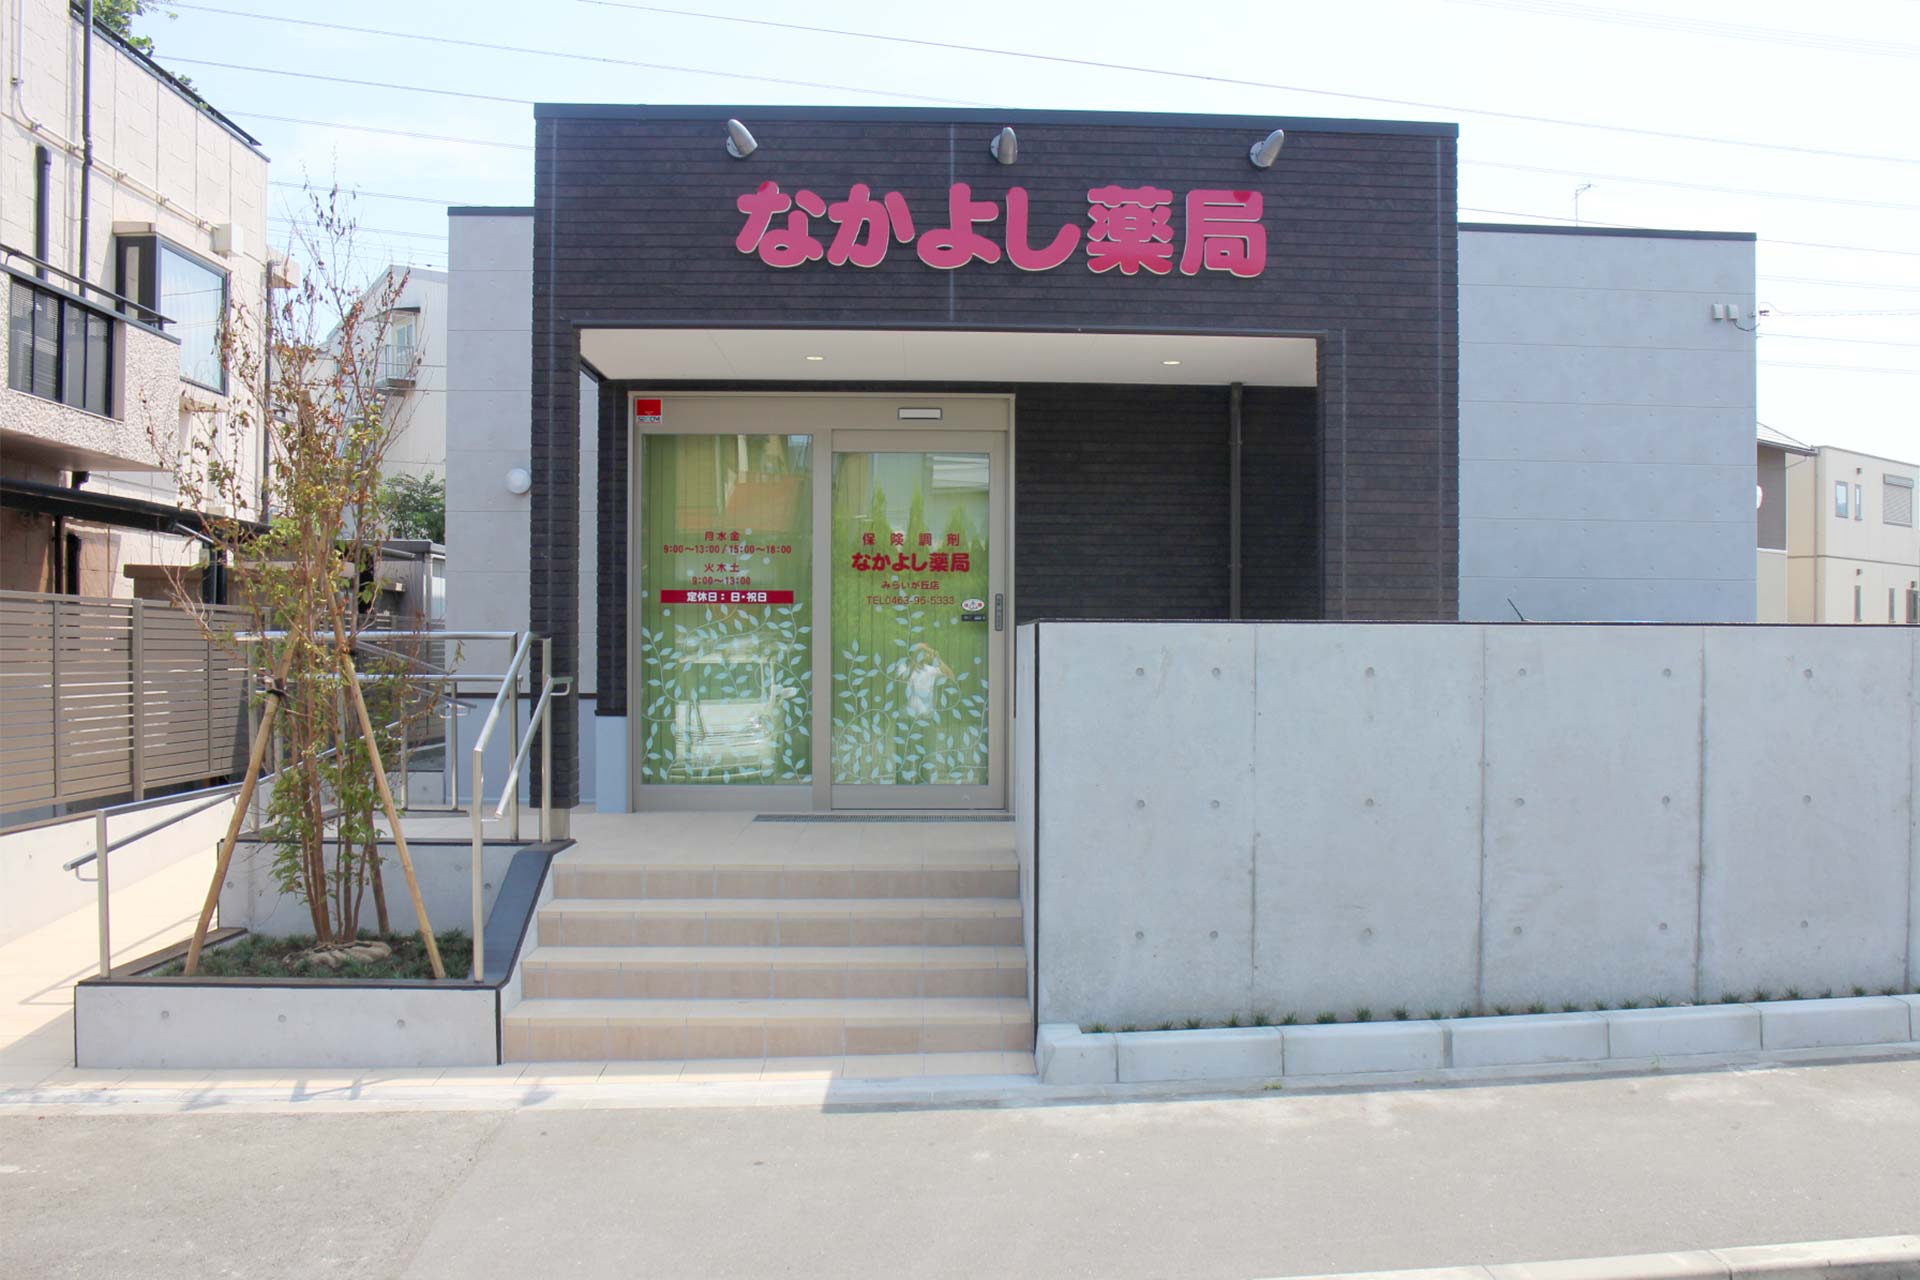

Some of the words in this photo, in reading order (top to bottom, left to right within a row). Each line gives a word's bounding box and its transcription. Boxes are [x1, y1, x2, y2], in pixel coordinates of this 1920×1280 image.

[736, 181, 1267, 277] なかよし薬局
[705, 531, 740, 541] 月水金
[852, 552, 971, 572] なかよし薬局
[704, 563, 740, 573] 火木土
[881, 580, 940, 590] みらいが丘店
